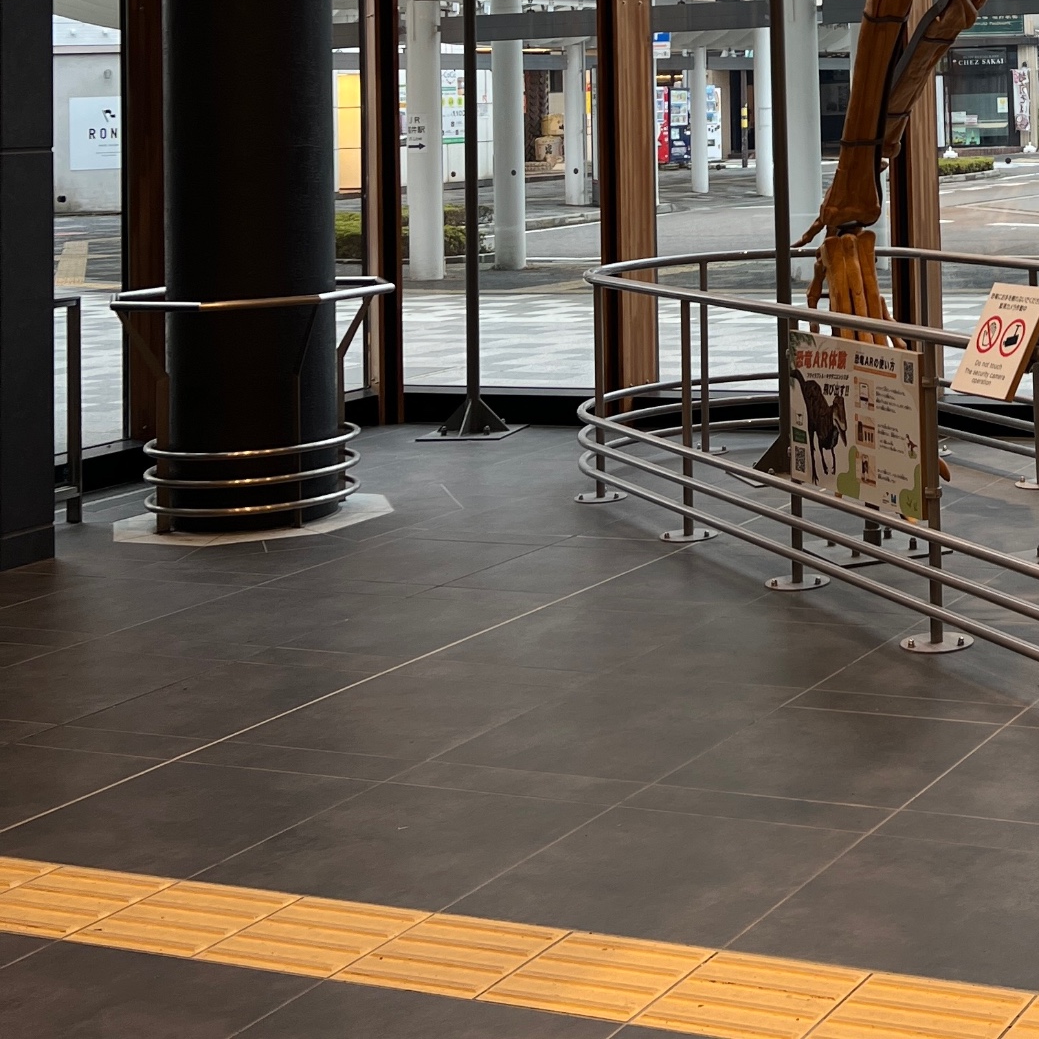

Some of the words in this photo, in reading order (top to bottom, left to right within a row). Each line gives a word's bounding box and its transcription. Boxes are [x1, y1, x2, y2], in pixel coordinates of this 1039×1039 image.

[981, 57, 1004, 65] SAKAI
[990, 362, 1003, 370] touch
[989, 373, 1006, 381] camera
